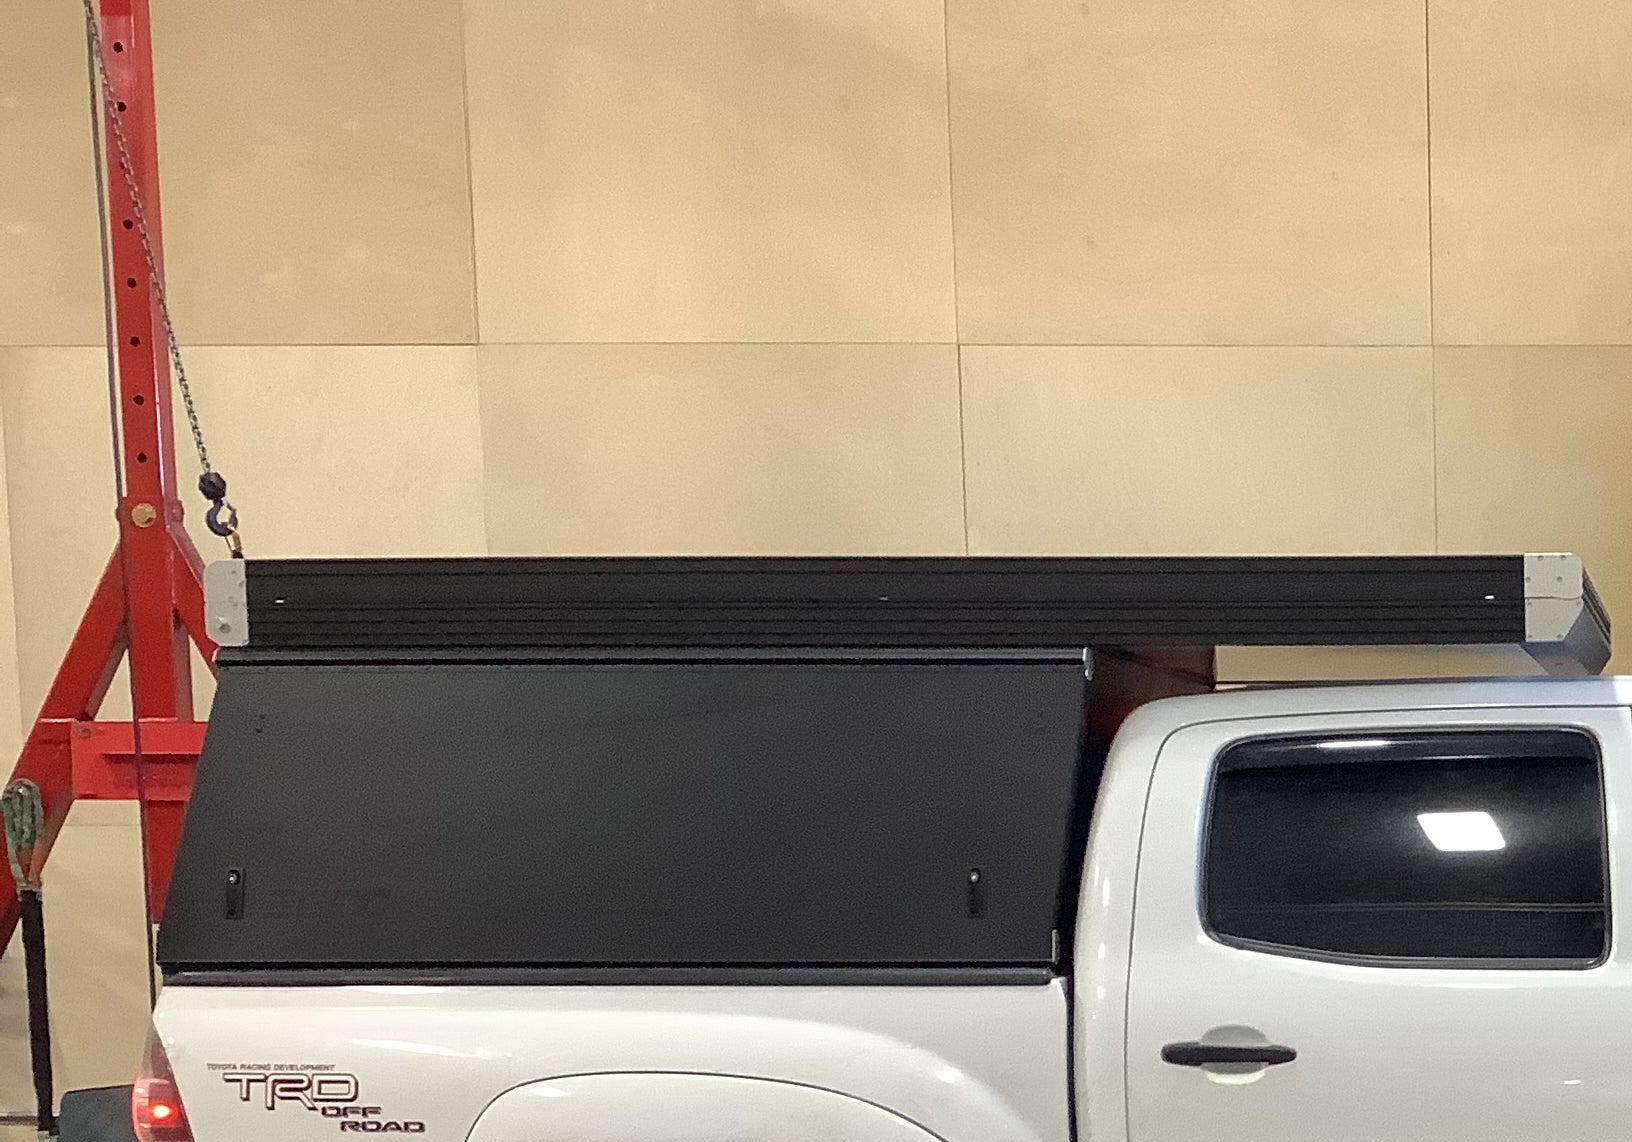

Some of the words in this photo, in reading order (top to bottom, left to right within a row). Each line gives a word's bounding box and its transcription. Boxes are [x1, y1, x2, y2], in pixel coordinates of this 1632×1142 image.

[206, 1063, 237, 1071] TOYOTA
[240, 1063, 272, 1071] RACING
[273, 1063, 336, 1072] DEVELOPMENT
[222, 1072, 359, 1111] TRD
[321, 1106, 382, 1118] OFF
[340, 1121, 426, 1133] ROAD
